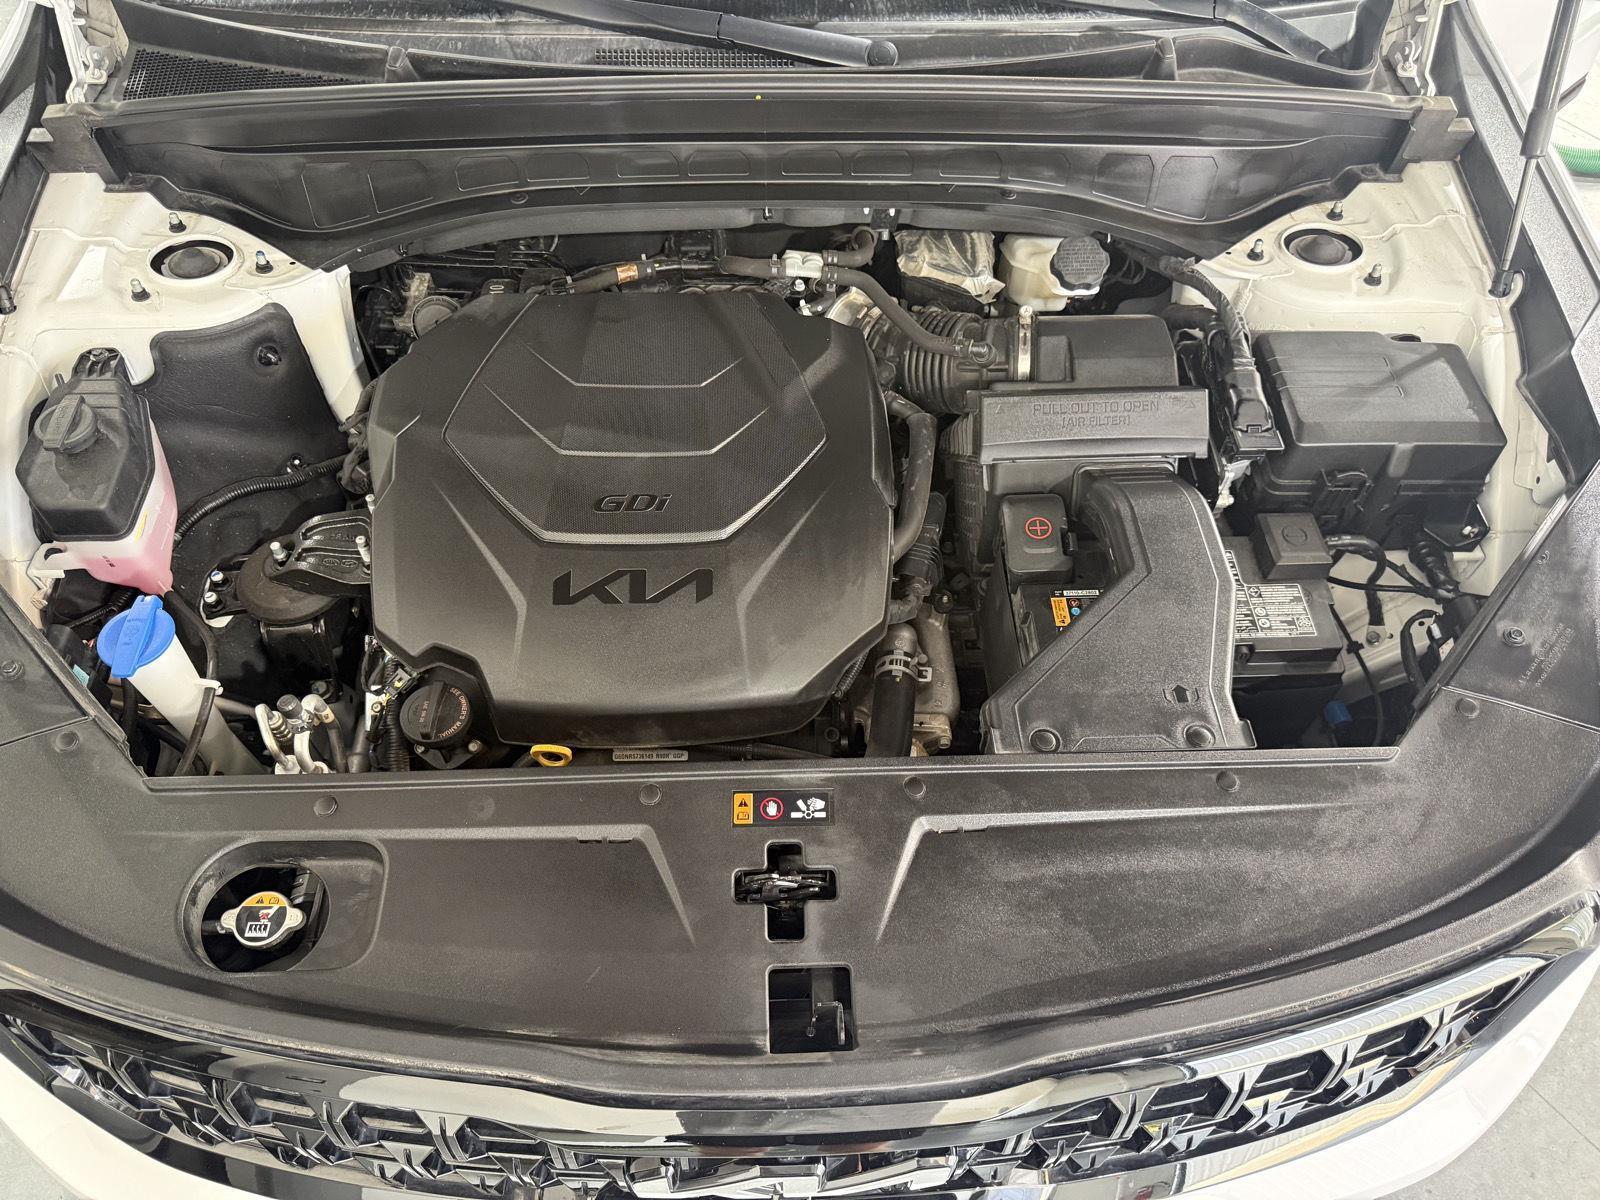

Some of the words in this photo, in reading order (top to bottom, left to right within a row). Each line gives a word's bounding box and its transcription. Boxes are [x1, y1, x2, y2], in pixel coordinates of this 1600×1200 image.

[1033, 403, 1068, 415] PULL
[1070, 402, 1098, 414] OUT
[1101, 401, 1119, 413] TO
[1123, 400, 1159, 412] OPEN
[593, 493, 673, 513] GDi
[552, 568, 714, 606] KIA
[449, 687, 462, 696] SEE
[458, 695, 468, 720] OWNER'S
[438, 720, 462, 739] MANUAL
